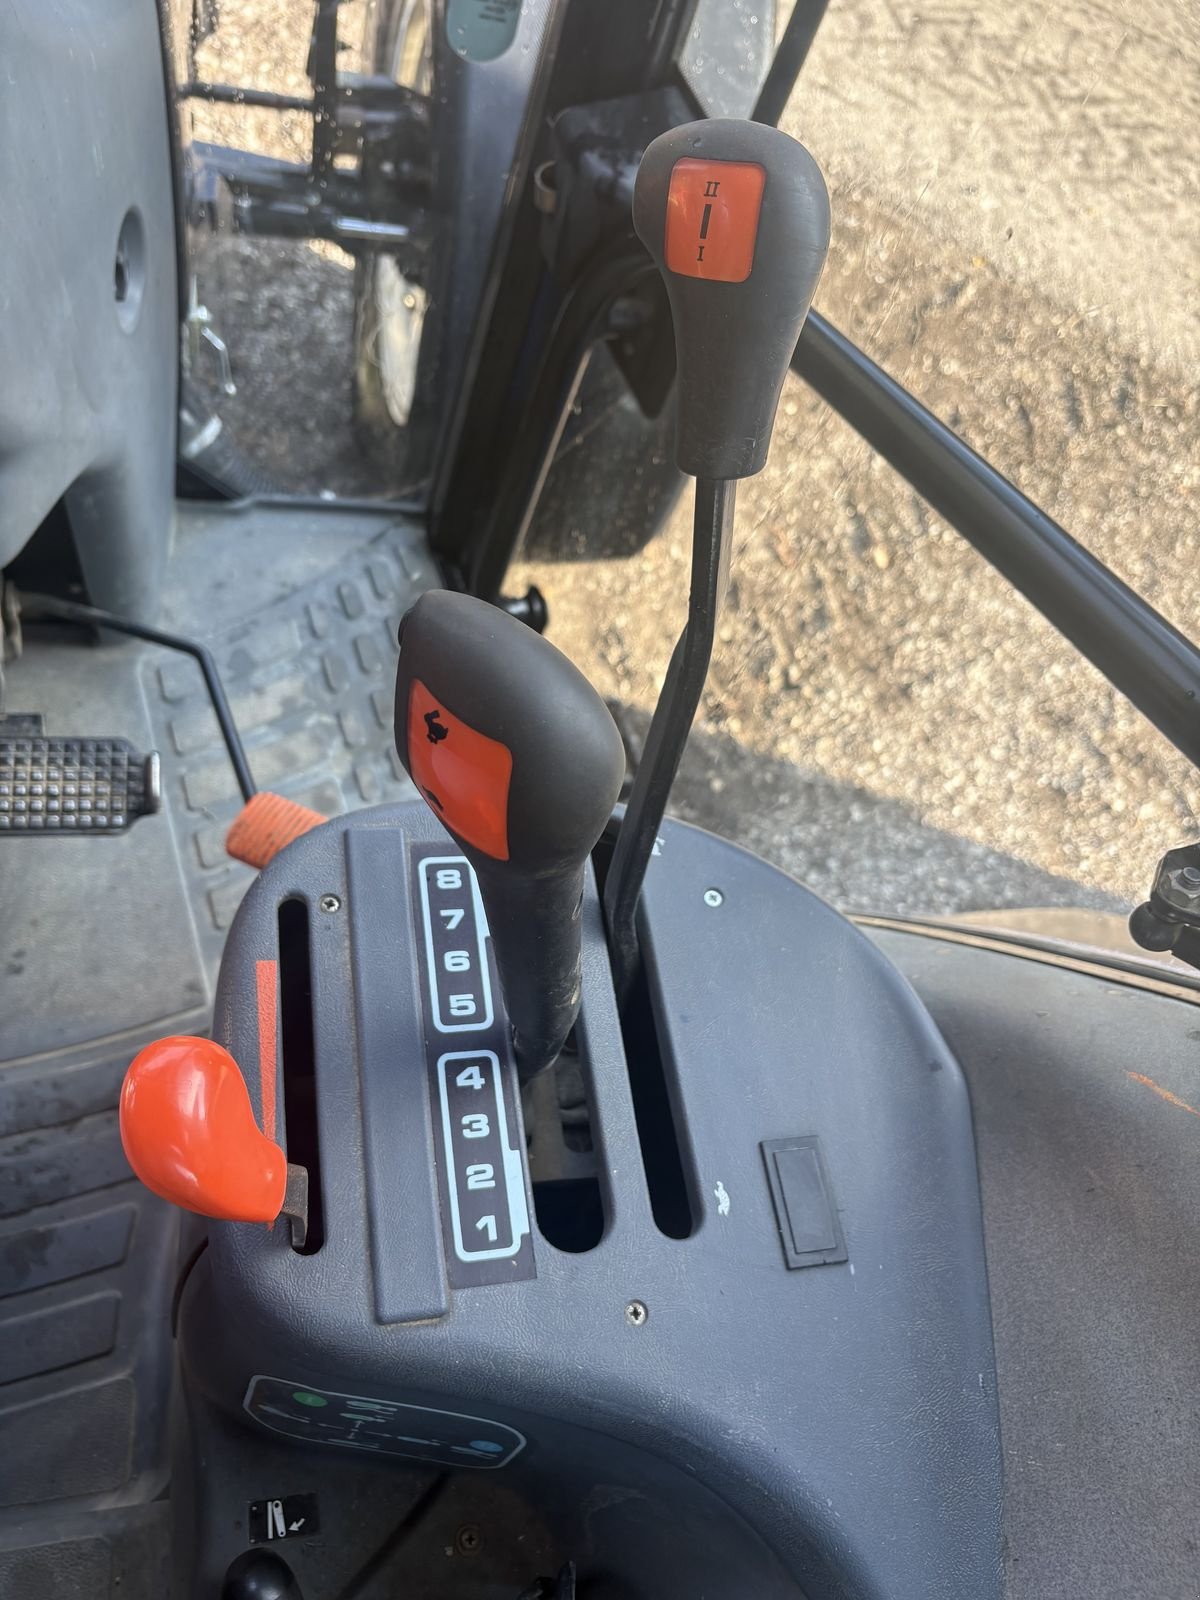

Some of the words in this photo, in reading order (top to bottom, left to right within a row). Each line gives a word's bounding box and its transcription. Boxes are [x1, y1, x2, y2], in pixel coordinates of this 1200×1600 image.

[436, 869, 462, 889] 8
[440, 908, 465, 929] 7
[443, 950, 471, 972] 6
[449, 993, 476, 1016] 5
[456, 1065, 485, 1090] 4
[461, 1113, 490, 1138] 3
[466, 1163, 496, 1190] 2
[475, 1214, 498, 1242] 1
